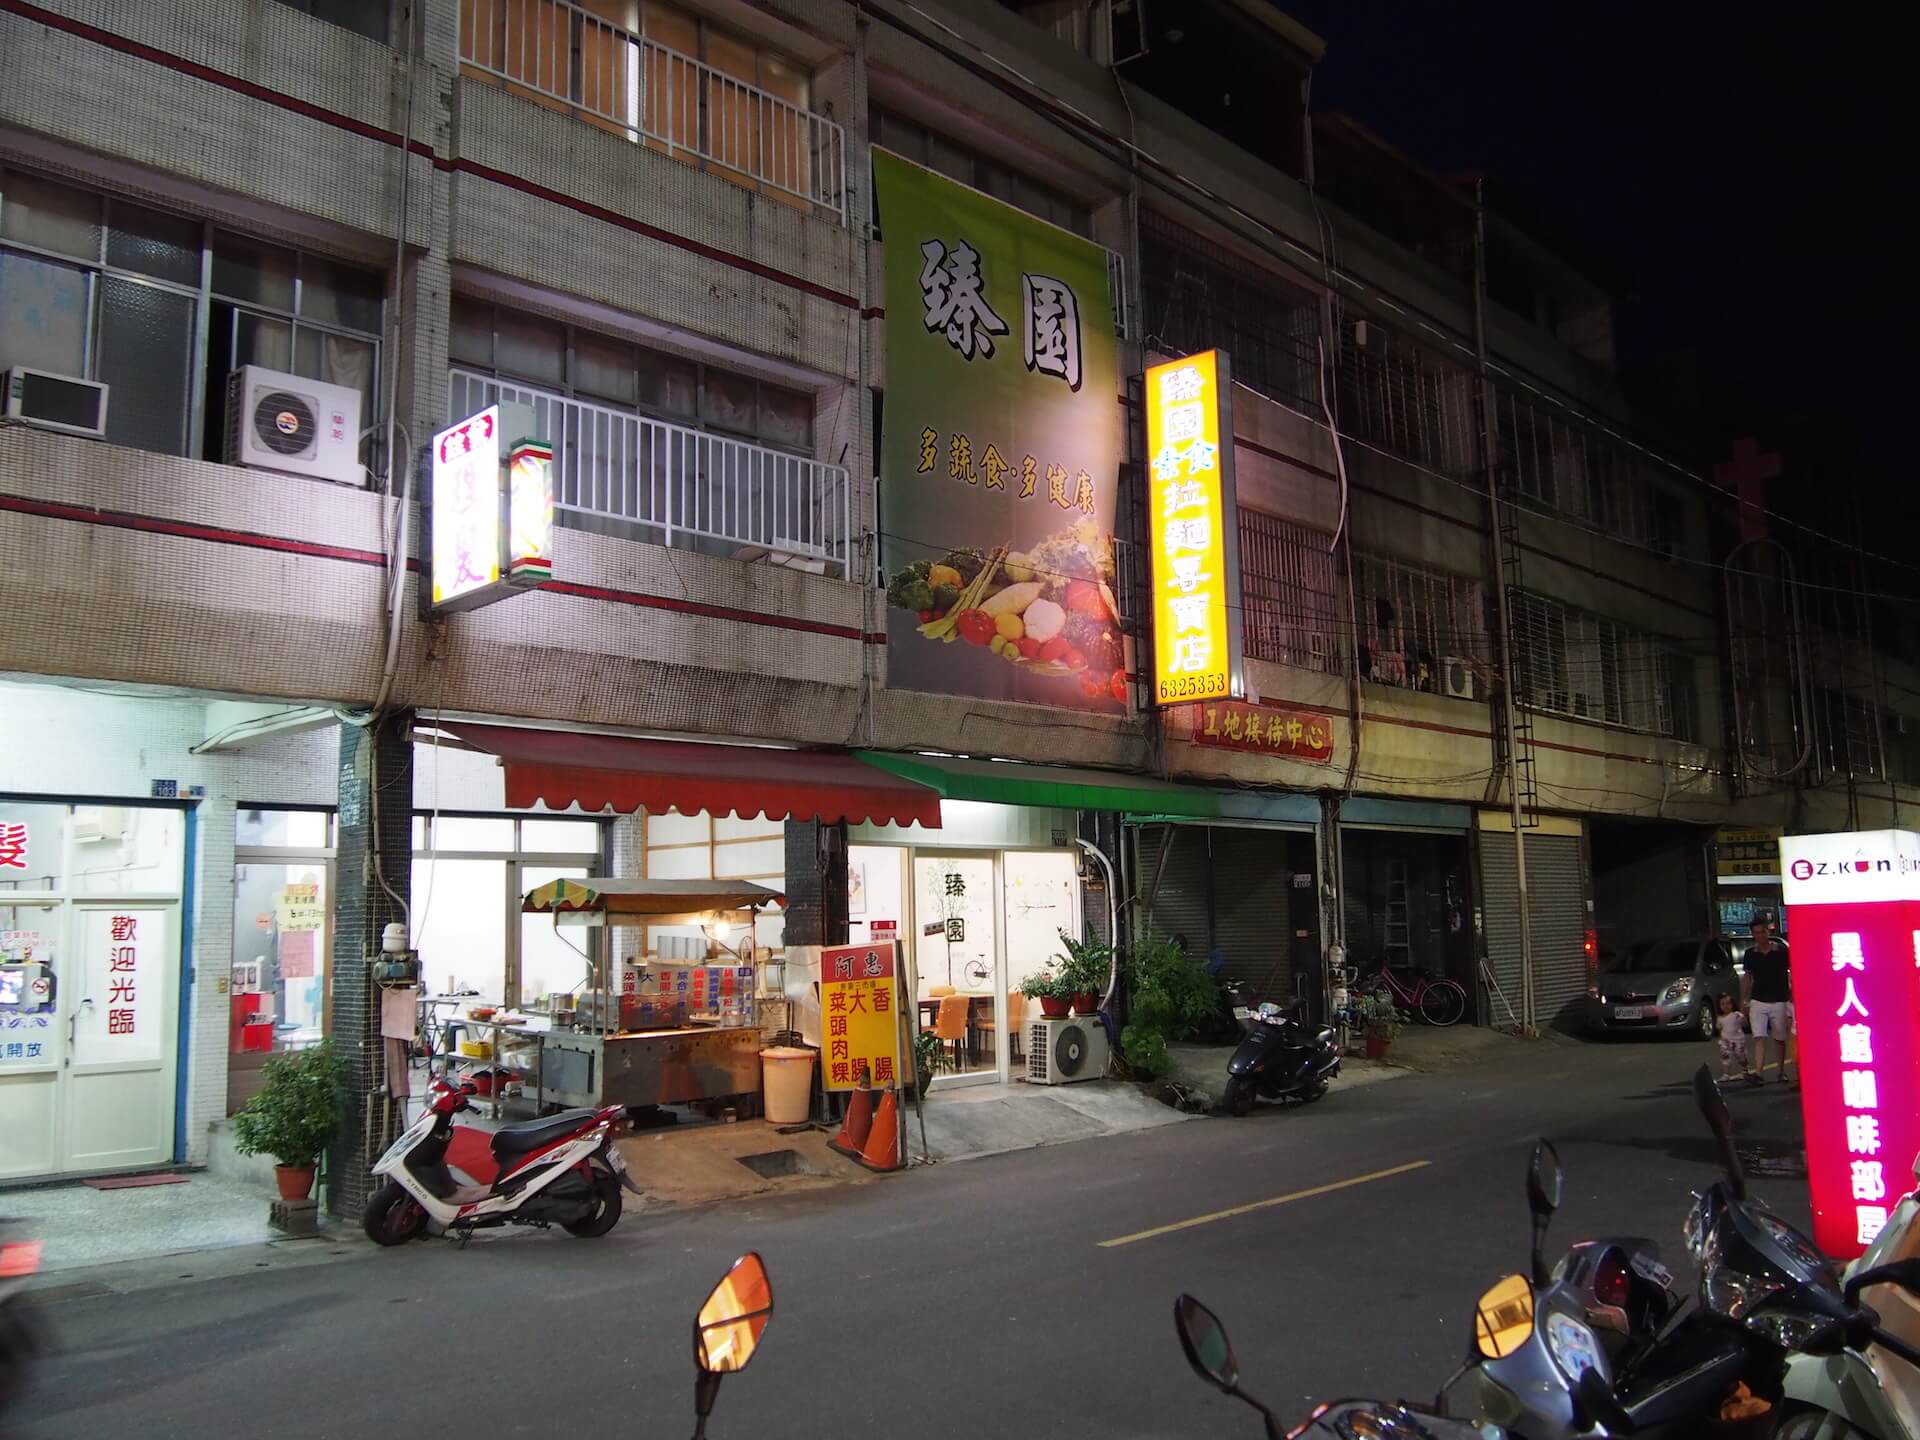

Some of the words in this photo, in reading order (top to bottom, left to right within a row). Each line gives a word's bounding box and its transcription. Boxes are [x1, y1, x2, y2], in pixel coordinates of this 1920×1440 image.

[919, 239, 1082, 392] 臻園
[1160, 672, 1225, 699] 6325353
[1203, 708, 1324, 750] 工地接待中心
[944, 873, 966, 942] 臻園
[108, 915, 137, 1035] 歡迎光臨
[834, 952, 884, 979] 阿惠
[829, 991, 849, 1084] 菜頭肉粿
[872, 987, 894, 1081] 香腸
[1831, 931, 1888, 1245] 異人館咖啡部屋
